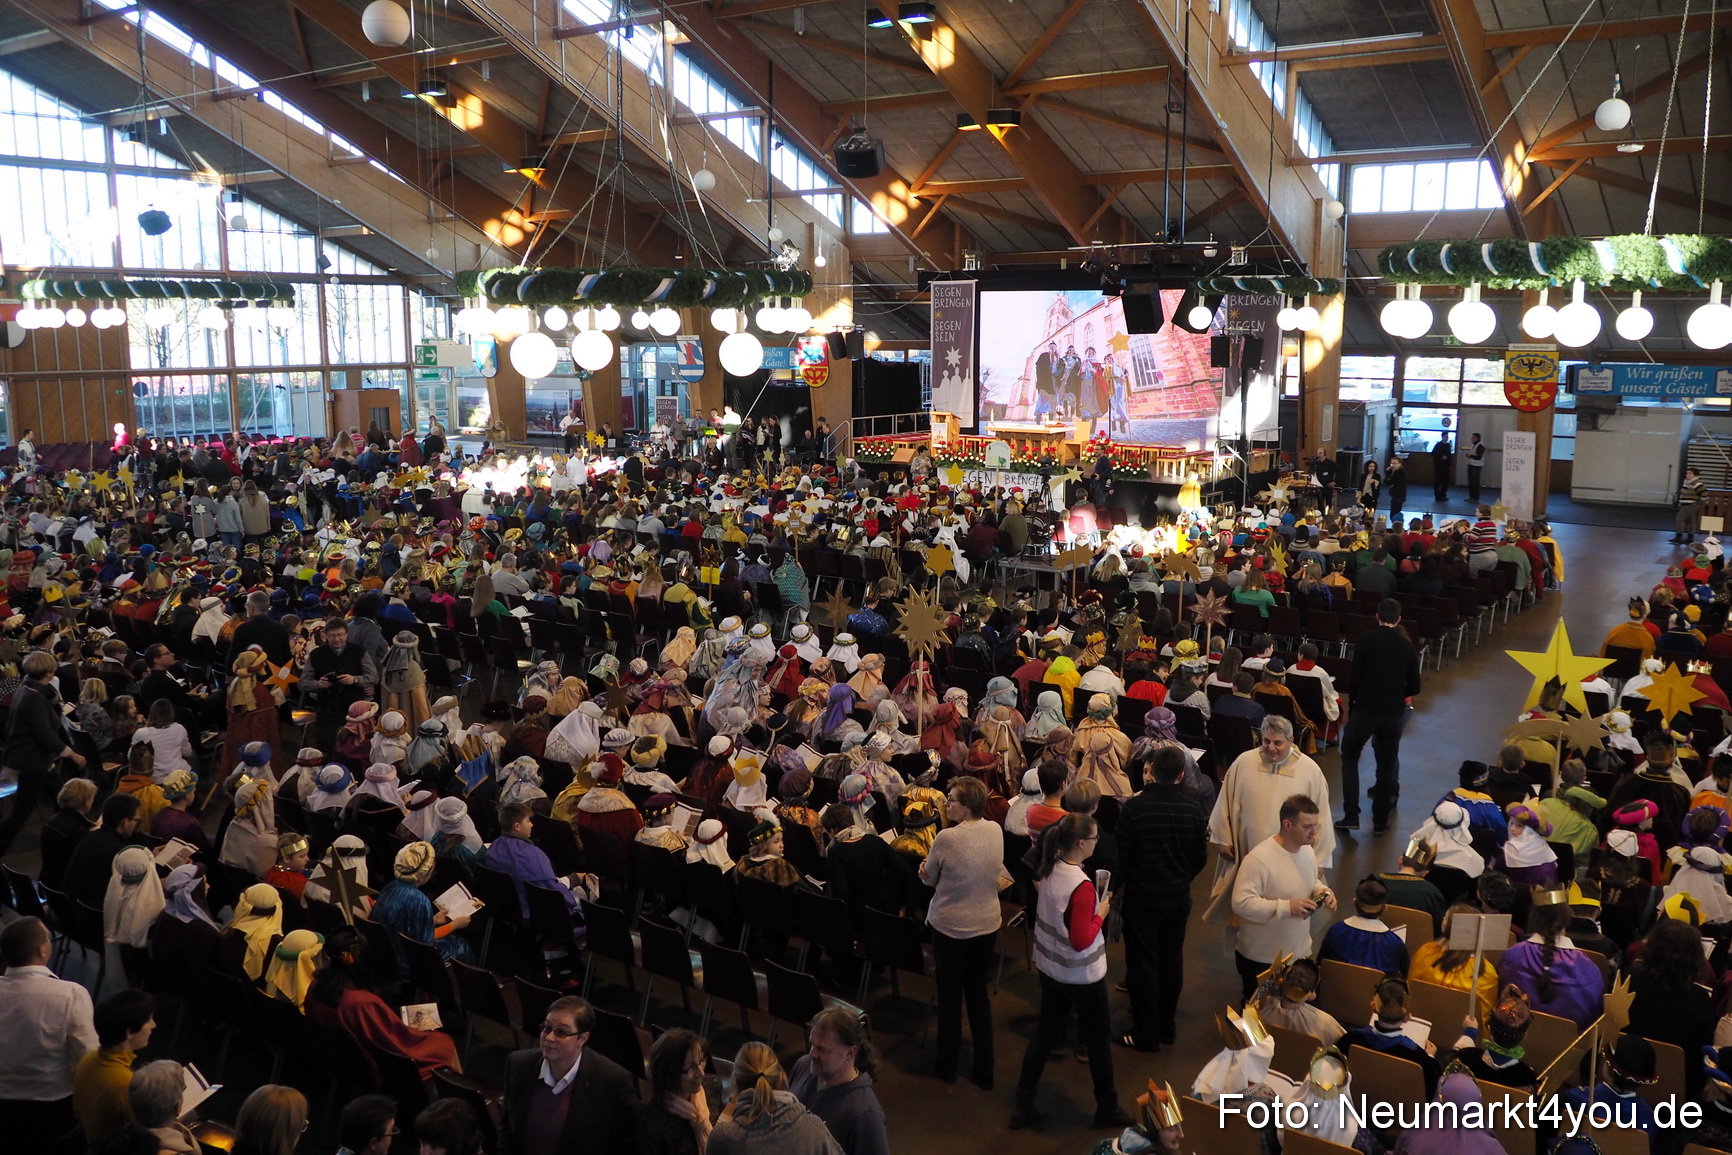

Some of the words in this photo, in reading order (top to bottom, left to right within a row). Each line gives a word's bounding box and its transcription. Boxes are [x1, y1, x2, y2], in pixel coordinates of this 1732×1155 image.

[934, 286, 962, 297] SEGEN
[934, 298, 972, 309] BRINGEN
[1230, 294, 1280, 307] BRINGEN
[934, 320, 962, 331] SEGEN
[1229, 320, 1266, 333] SEGEN
[934, 331, 956, 342] SEIN
[1627, 367, 1653, 379] Wir
[1653, 365, 1704, 385] grüßen
[1620, 384, 1662, 394] unsere
[1665, 382, 1708, 395] Gäste!
[1506, 435, 1526, 444] SEGEN
[1505, 443, 1533, 451] BRINGEN
[1505, 457, 1525, 466] SEGEN
[1505, 464, 1520, 472] SEIN
[962, 470, 993, 485] EGEN
[1004, 474, 1044, 486] BRINGE
